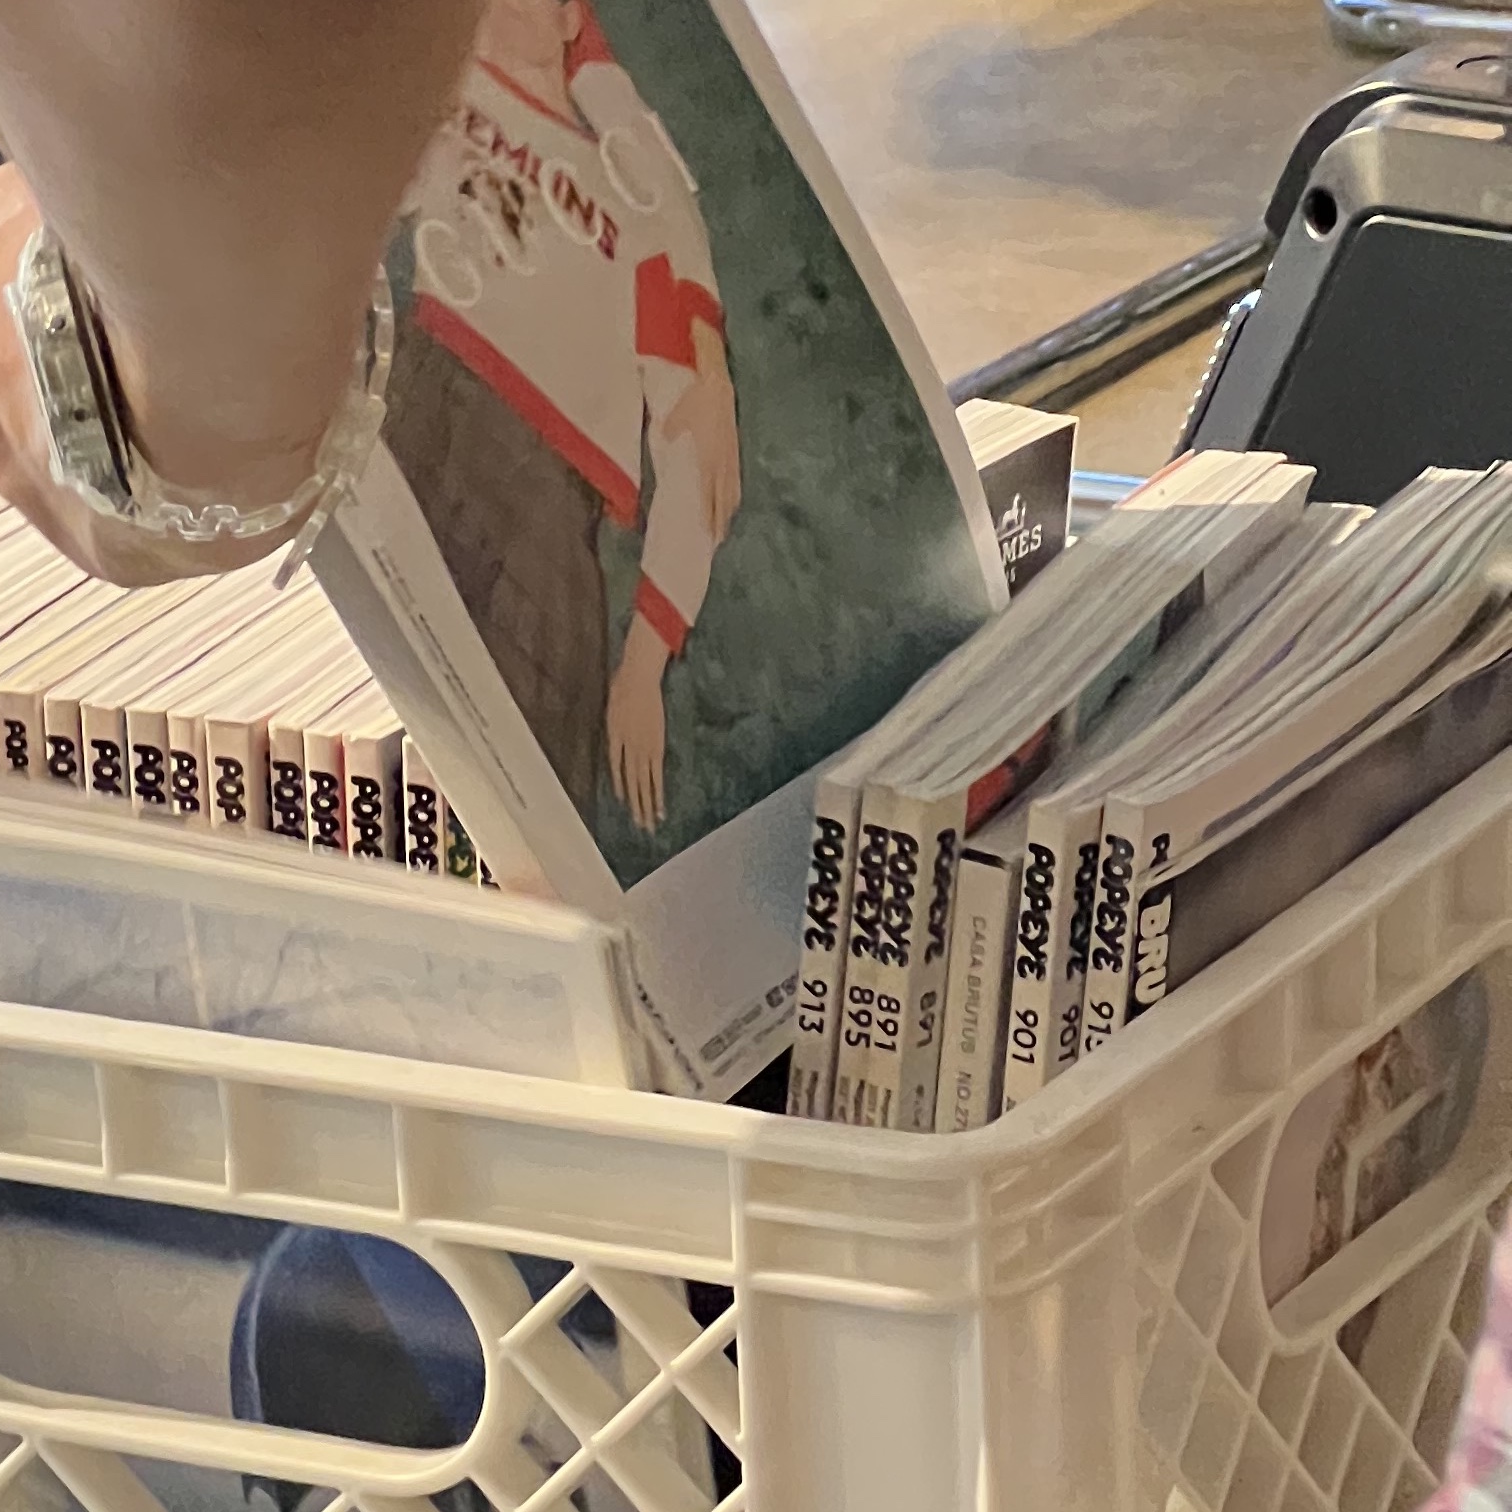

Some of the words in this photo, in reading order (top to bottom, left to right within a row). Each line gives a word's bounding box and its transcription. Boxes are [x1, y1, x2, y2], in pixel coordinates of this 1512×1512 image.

[803, 816, 846, 952] POPEYE
[850, 823, 889, 961] POPEYE
[879, 829, 920, 968] POPEYE
[1016, 842, 1055, 981] POPEYE
[1092, 833, 1135, 973] POPEYE
[798, 979, 828, 1035] 913
[844, 985, 875, 1049] 895
[874, 993, 901, 1053] 891
[1011, 1007, 1040, 1065] 901
